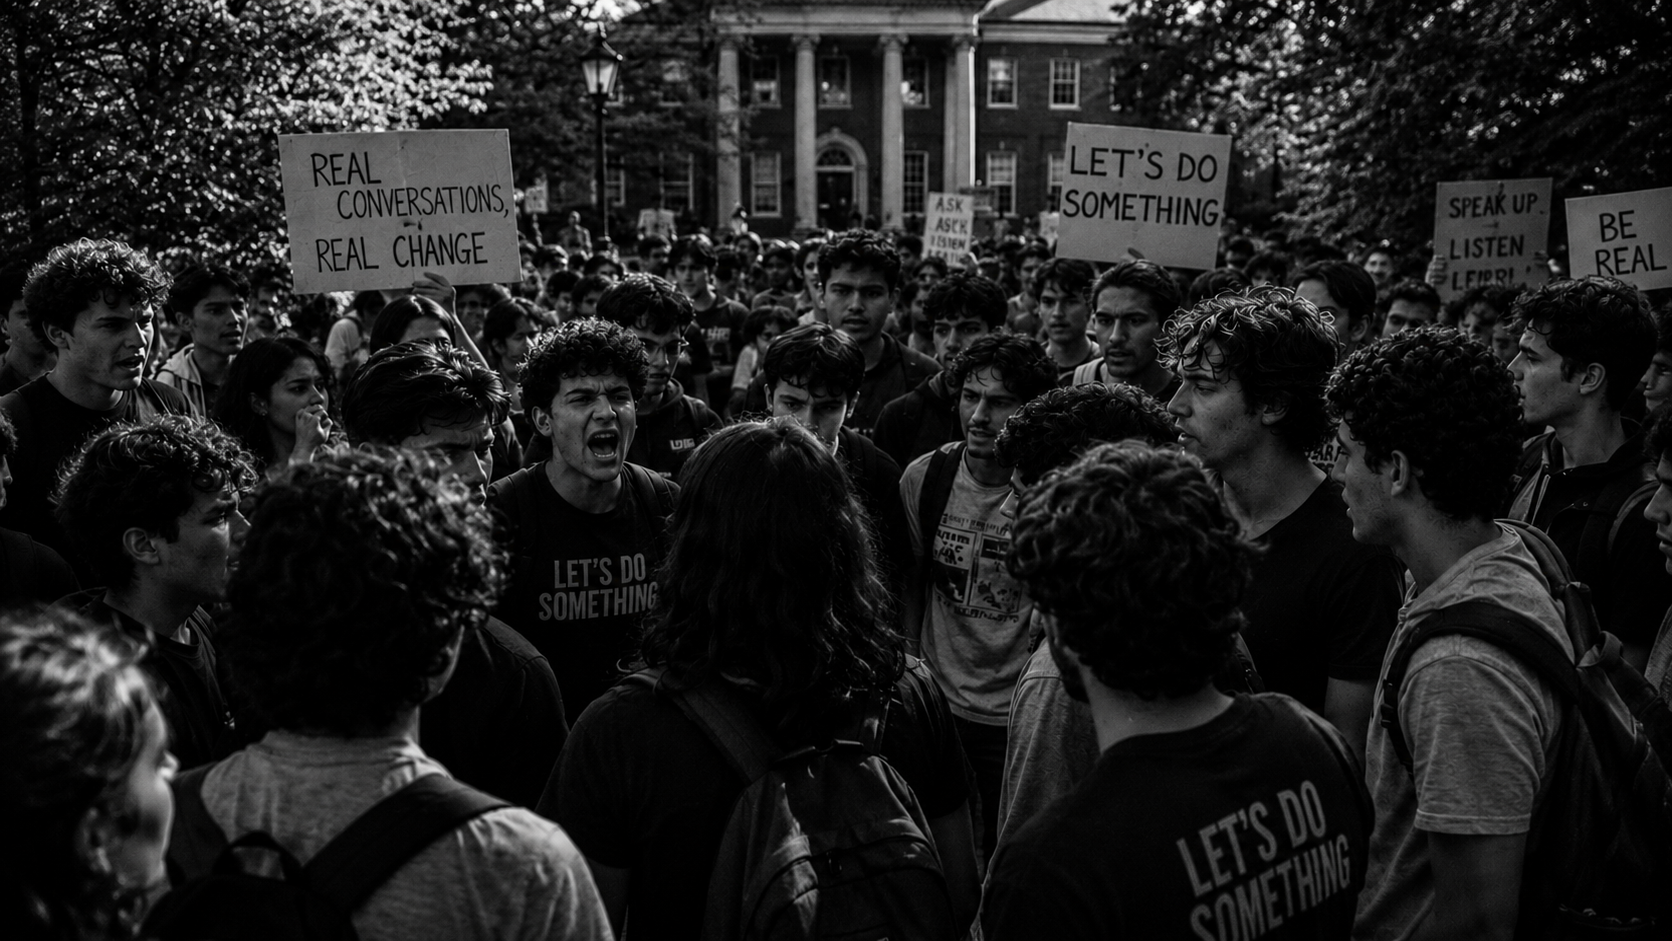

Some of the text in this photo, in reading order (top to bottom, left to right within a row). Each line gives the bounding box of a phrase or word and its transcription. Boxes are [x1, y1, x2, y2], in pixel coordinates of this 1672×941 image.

[311, 151, 382, 187] REAL
[1070, 145, 1218, 183] LET'S DO
[337, 184, 509, 220] CONVERSATIONS,
[935, 197, 964, 213] ASK
[1063, 189, 1219, 227] SOMETHING
[1449, 194, 1506, 218] SPEAK
[1599, 209, 1637, 243] BE
[315, 232, 488, 273] REAL CHANGE
[1450, 234, 1524, 260] LISTEN
[1595, 243, 1667, 277] REAL
[554, 552, 646, 589] LET'S DO
[538, 581, 659, 621] SOMETHING
[1175, 780, 1327, 898] LET'S DO
[1189, 833, 1350, 941] SOMETHING
